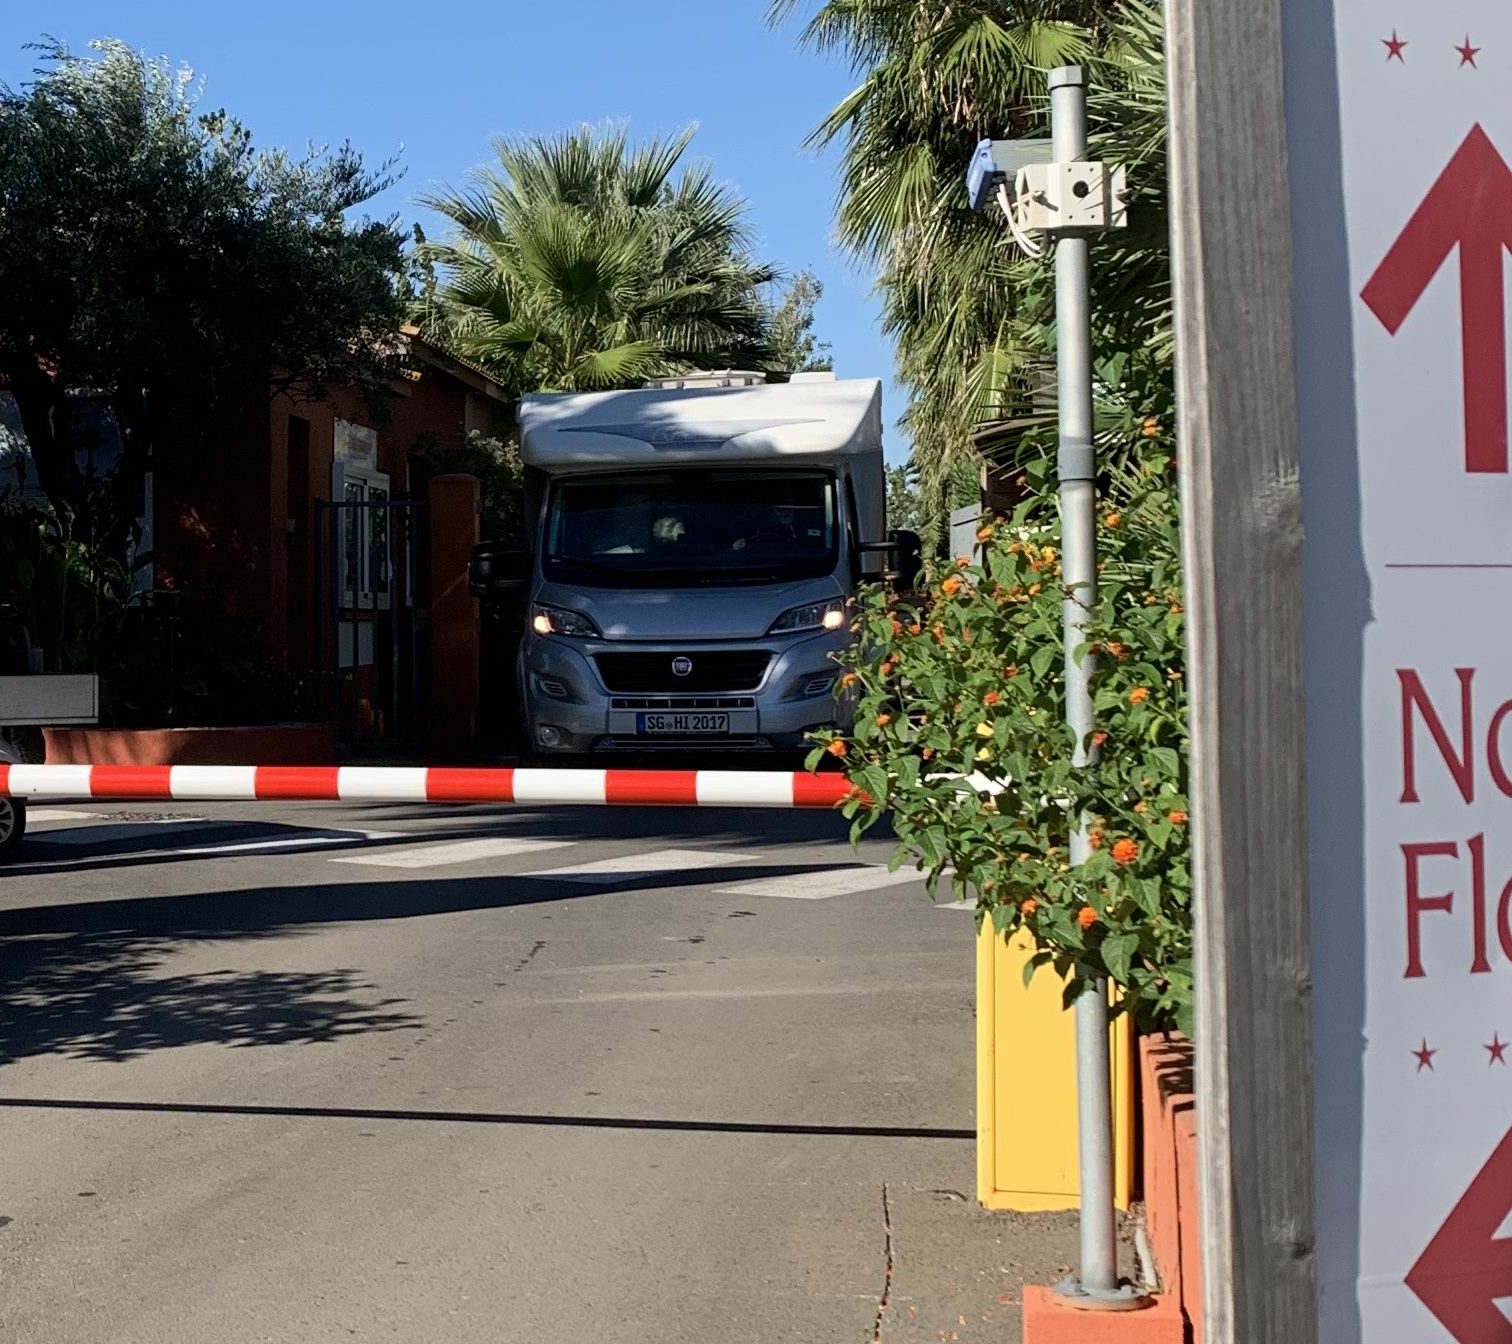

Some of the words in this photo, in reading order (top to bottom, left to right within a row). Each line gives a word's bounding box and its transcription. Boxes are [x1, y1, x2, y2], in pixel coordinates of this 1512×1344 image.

[647, 715, 665, 730] SG
[674, 715, 691, 730] HI
[692, 715, 726, 730] 2017
